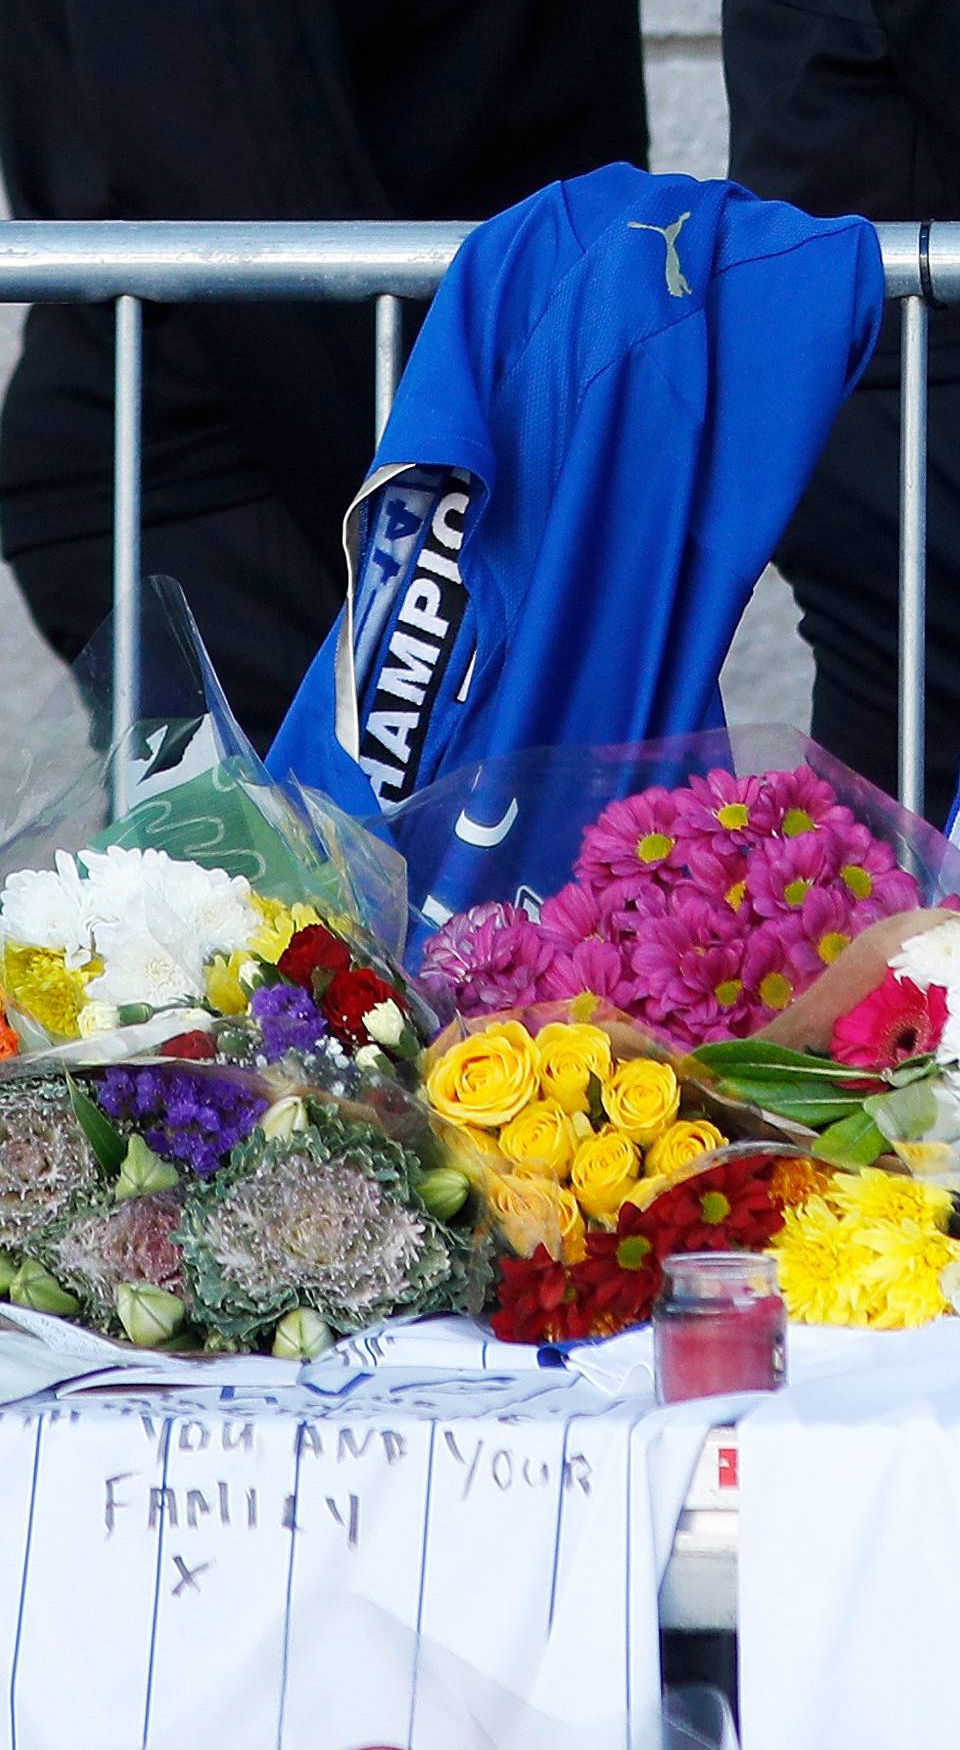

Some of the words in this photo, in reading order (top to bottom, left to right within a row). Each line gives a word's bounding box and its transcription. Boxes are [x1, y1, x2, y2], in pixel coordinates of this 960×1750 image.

[296, 1420, 408, 1465] AND
[443, 1429, 594, 1502] YOUR
[104, 1471, 361, 1551] FAMILY
